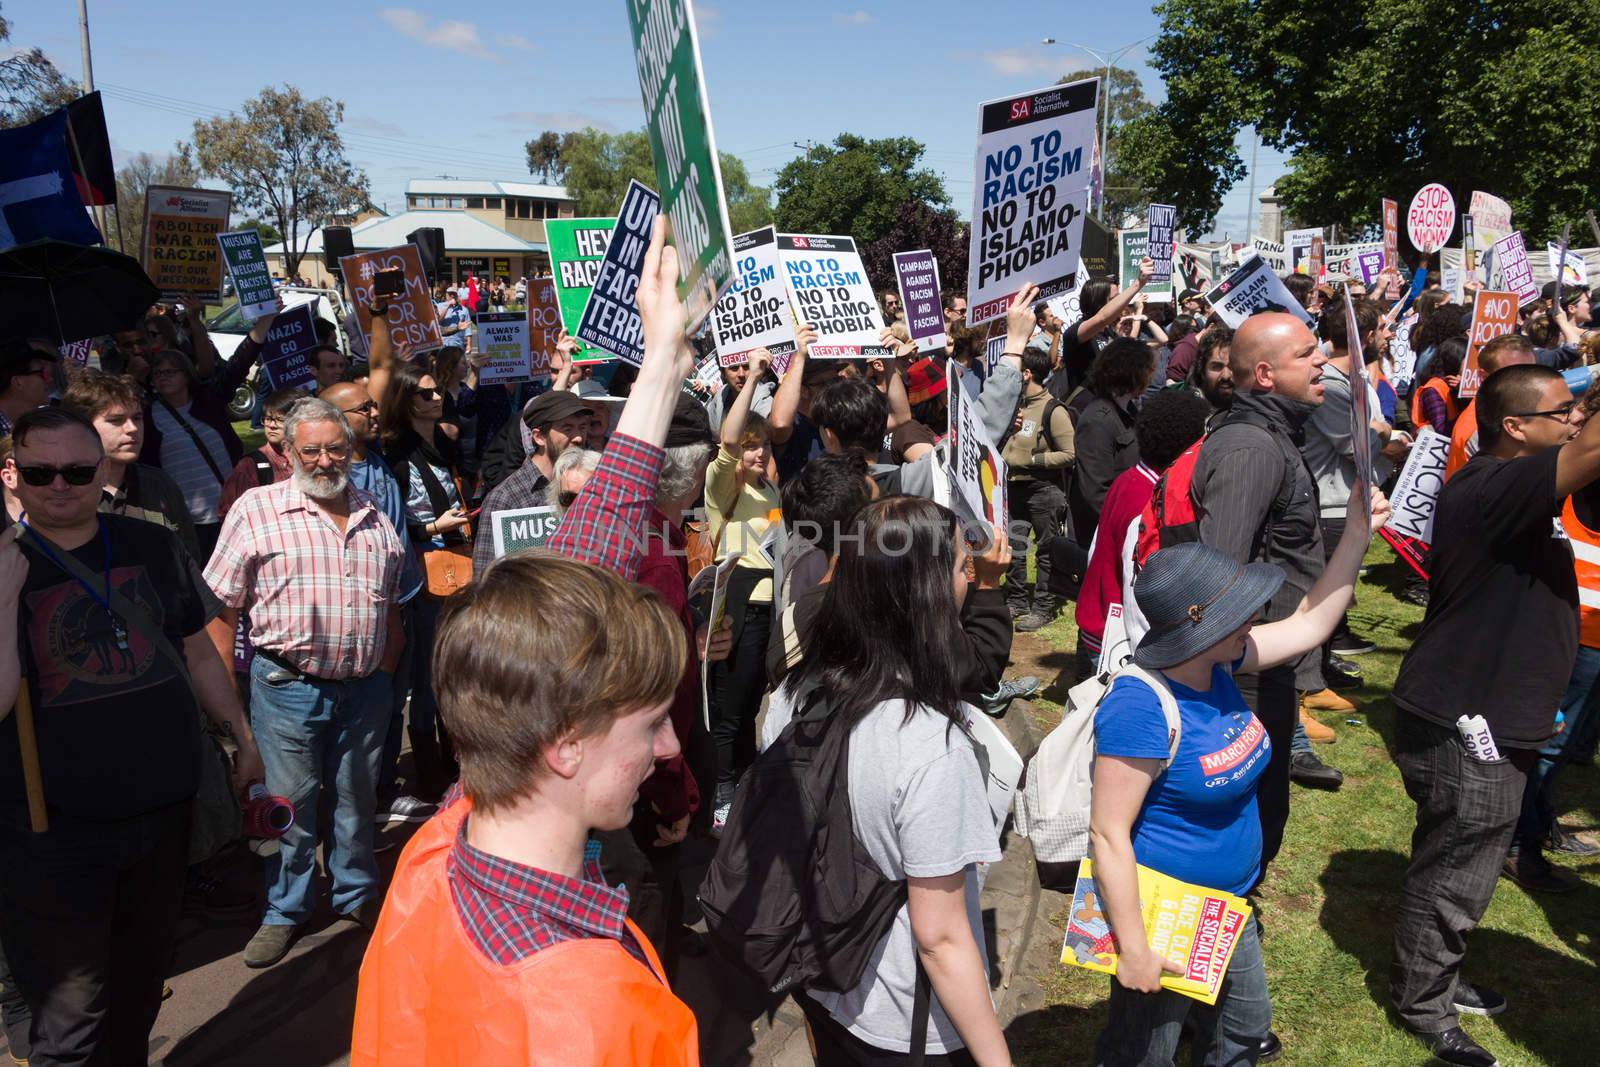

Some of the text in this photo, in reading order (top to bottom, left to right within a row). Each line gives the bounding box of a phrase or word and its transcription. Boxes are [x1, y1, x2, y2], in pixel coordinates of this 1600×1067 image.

[1011, 93, 1061, 119] SA Socialist
[1033, 99, 1070, 115] Alternative
[658, 72, 685, 189] NOT
[985, 129, 1062, 181] NO TO
[983, 147, 1083, 209] RACISM
[1417, 188, 1449, 209] STOP
[981, 184, 1056, 238] NO TO
[1151, 207, 1175, 227] UNITY
[1410, 209, 1452, 228] RACISM
[156, 221, 219, 234] ABOLISH
[669, 162, 710, 281] WARS
[155, 233, 217, 247] WAR AND
[222, 234, 257, 248] MUSLIMS
[792, 238, 808, 248] SA
[980, 203, 1080, 264] ISLAMO-
[1151, 227, 1171, 242] IN THE
[1414, 229, 1447, 246] NOW
[154, 248, 217, 262] RACISM
[238, 250, 253, 260] ARE
[617, 233, 645, 270] IN
[978, 229, 1069, 290] PHOBIA
[1149, 243, 1172, 258] FACE OF
[160, 264, 184, 274] NOT
[232, 261, 267, 276] WELCOME
[786, 259, 840, 274] NO TO
[900, 260, 932, 272] CAMPAIGN
[240, 276, 269, 289] RACISTS
[595, 260, 641, 308] FAC
[790, 271, 862, 289] RACISM
[906, 274, 932, 287] AGAINST
[1040, 280, 1071, 298] ORG.AU
[1219, 282, 1232, 293] SA
[243, 293, 257, 303] ARE
[714, 286, 762, 316] NO TO
[796, 287, 850, 306] NO TO
[910, 288, 933, 301] RACISM
[1224, 274, 1268, 312] RECLAIM
[1234, 286, 1269, 316] WHAT?
[386, 301, 417, 325] OR
[716, 297, 785, 331] ISLAMO-
[801, 301, 876, 321] ISLAMO-
[918, 303, 931, 314] AND
[1484, 298, 1510, 319] #NO
[267, 320, 303, 342] NAZIS
[486, 326, 520, 335] ALWAYS
[719, 313, 783, 346] PHOBIA
[807, 316, 876, 335] PHOBIA
[914, 316, 939, 329] FASCISM
[280, 340, 297, 354] GO
[582, 327, 597, 341] #NO
[597, 333, 617, 352] ROOM
[618, 341, 631, 356] FOR
[631, 348, 645, 363] RAC
[769, 344, 793, 355] ORG.AU
[286, 354, 305, 368] AND
[495, 366, 514, 374] LAND
[1395, 438, 1450, 536] RACISM
[510, 517, 557, 541] MUS
[1477, 728, 1489, 745] TO
[1204, 742, 1247, 769] MARCH
[1242, 726, 1258, 746] FOR
[1206, 900, 1221, 917] THE
[1225, 911, 1239, 931] THE
[1151, 911, 1175, 956] GENDE
[1191, 919, 1220, 982] SOCIALIST
